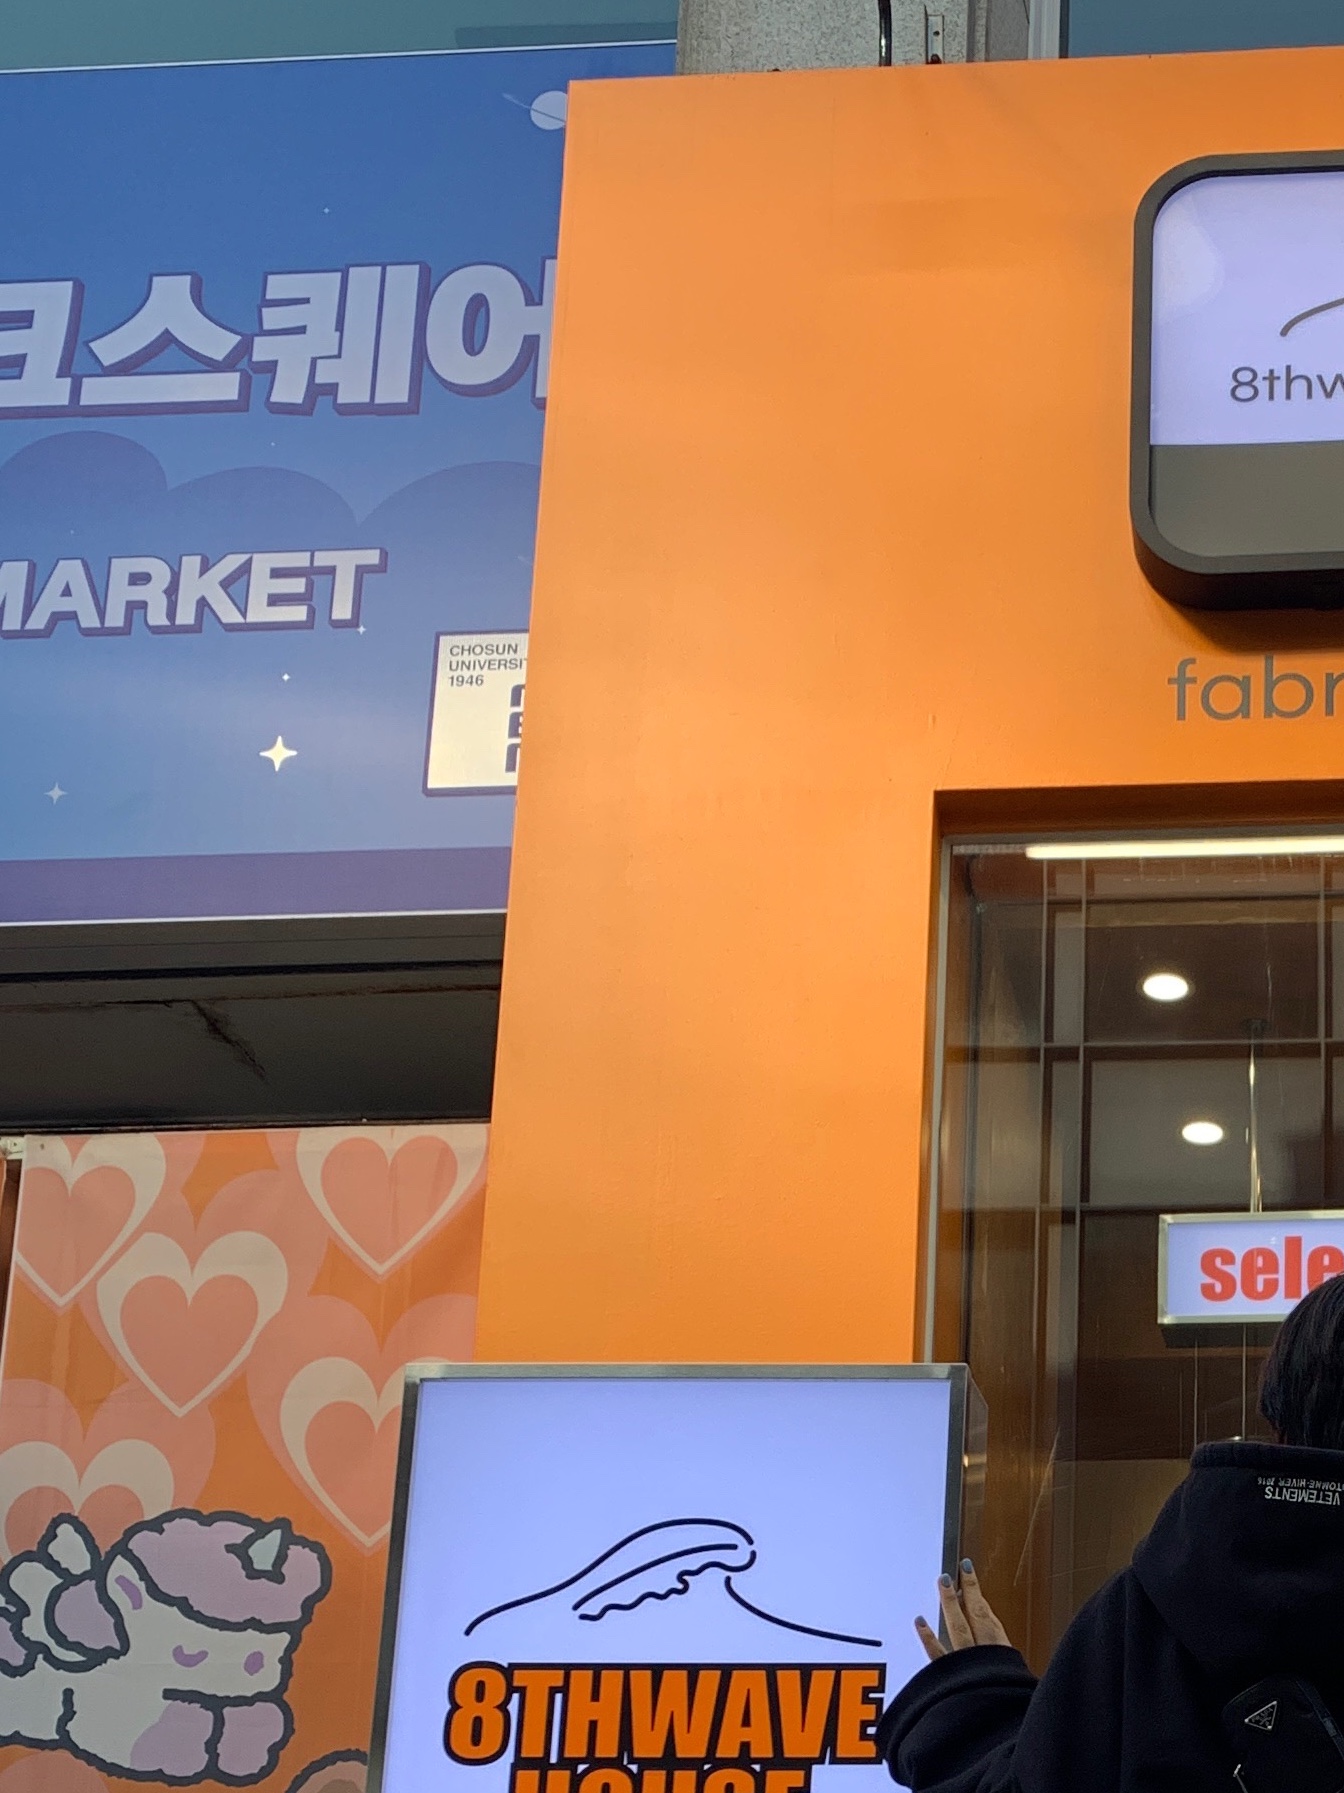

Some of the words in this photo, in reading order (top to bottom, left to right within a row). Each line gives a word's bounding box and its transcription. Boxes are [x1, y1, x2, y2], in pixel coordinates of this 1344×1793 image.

[449, 643, 519, 657] CHOSUN
[448, 657, 527, 672] UNIVERSI
[448, 674, 484, 687] 1946
[1264, 1486, 1341, 1506] VETEMENTS
[443, 1661, 887, 1767] 8THWAVE
